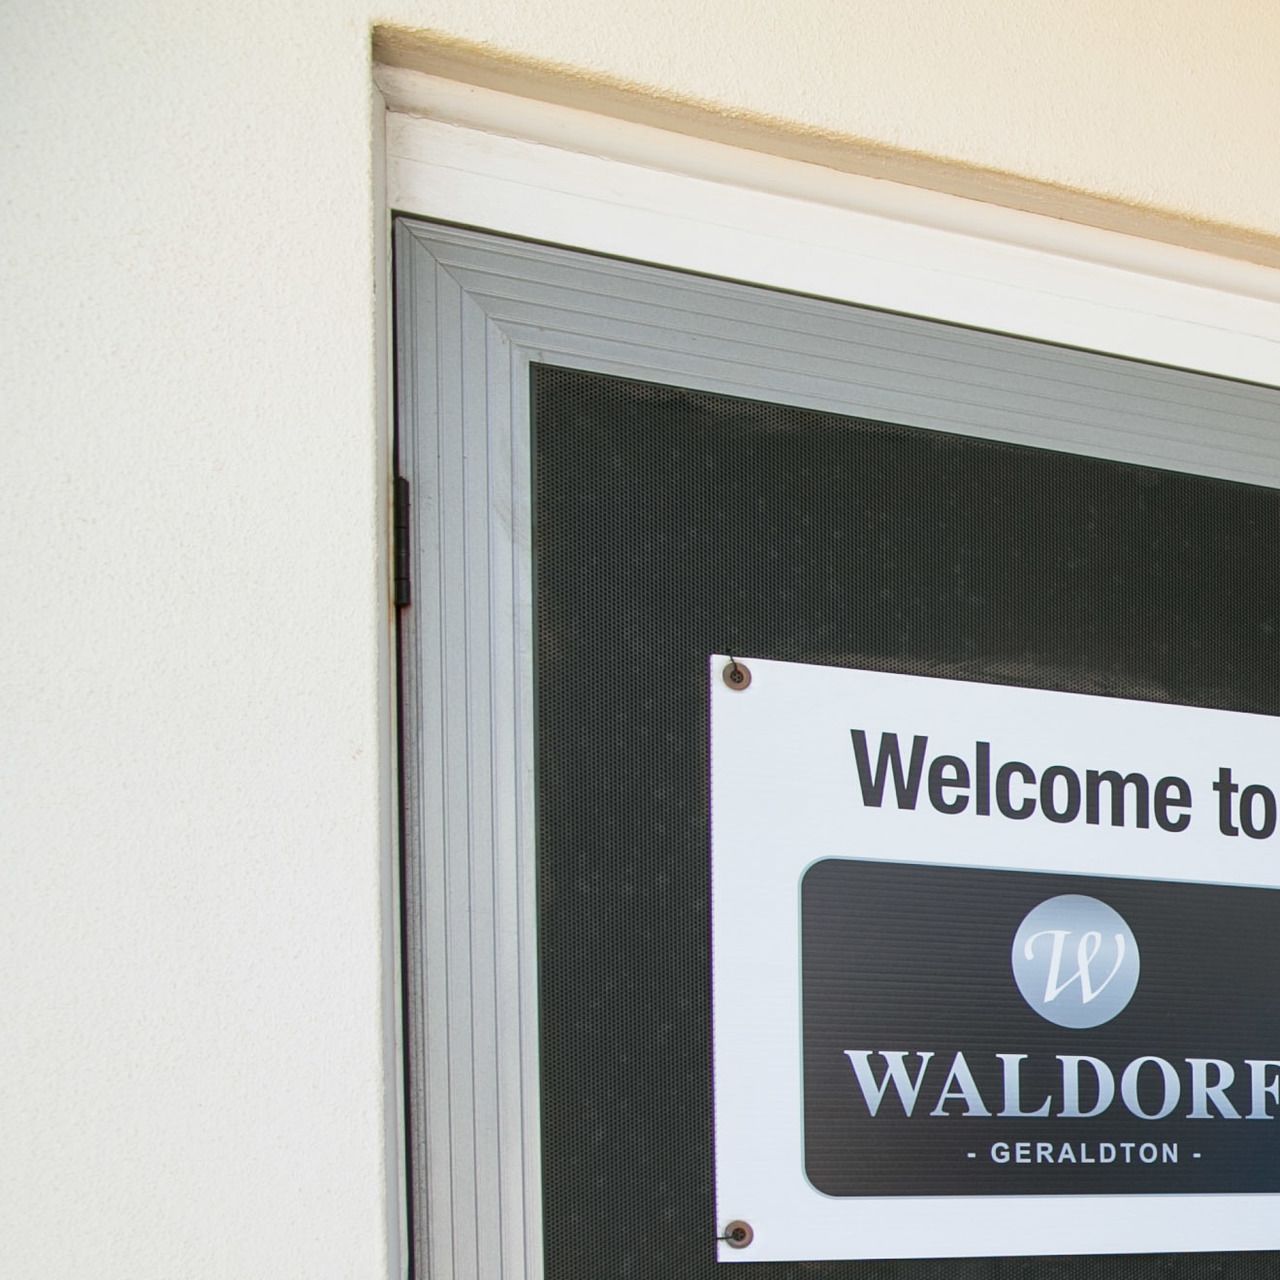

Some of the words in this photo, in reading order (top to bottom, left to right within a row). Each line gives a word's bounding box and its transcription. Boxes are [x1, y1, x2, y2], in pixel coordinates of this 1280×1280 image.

[850, 729, 1192, 832] Welcome
[1213, 767, 1277, 839] to
[1024, 930, 1125, 1004] W
[991, 1142, 1179, 1164] GERALDTON
